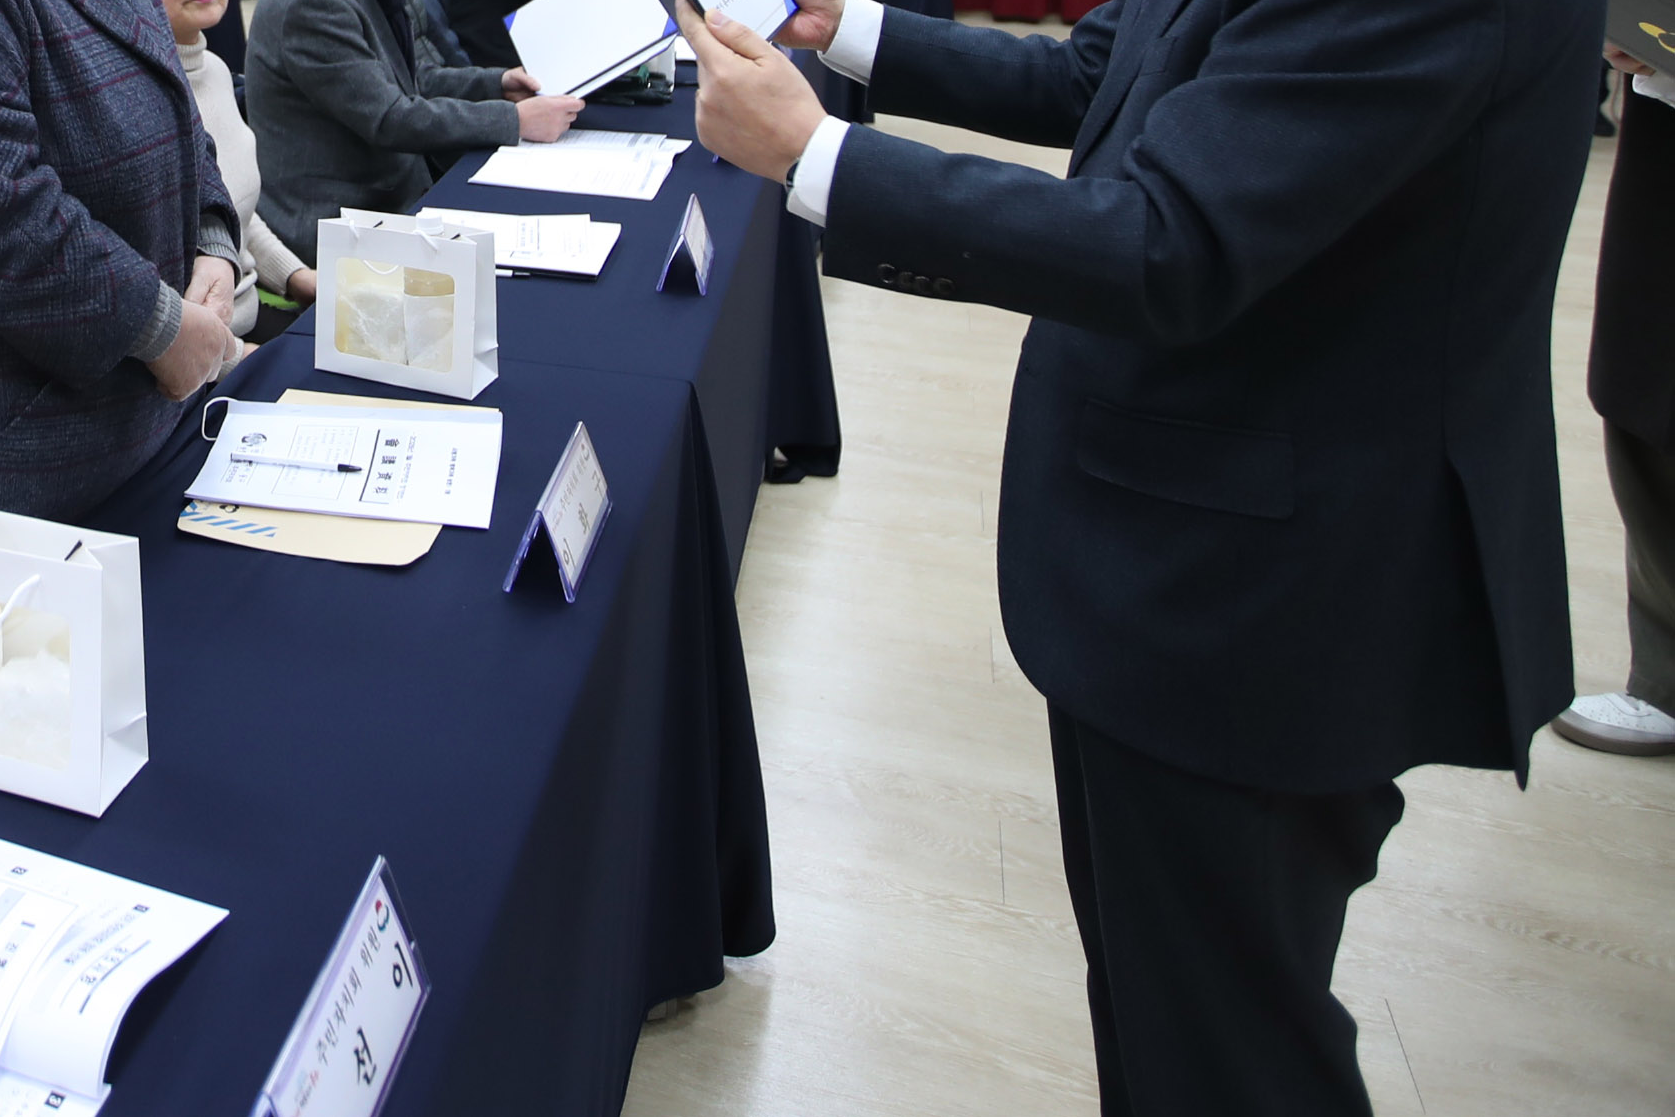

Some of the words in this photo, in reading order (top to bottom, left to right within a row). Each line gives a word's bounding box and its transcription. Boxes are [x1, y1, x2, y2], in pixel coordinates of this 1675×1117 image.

[316, 966, 362, 1066] 주민자치회
[360, 925, 381, 970] 위원
[392, 940, 414, 988] 이
